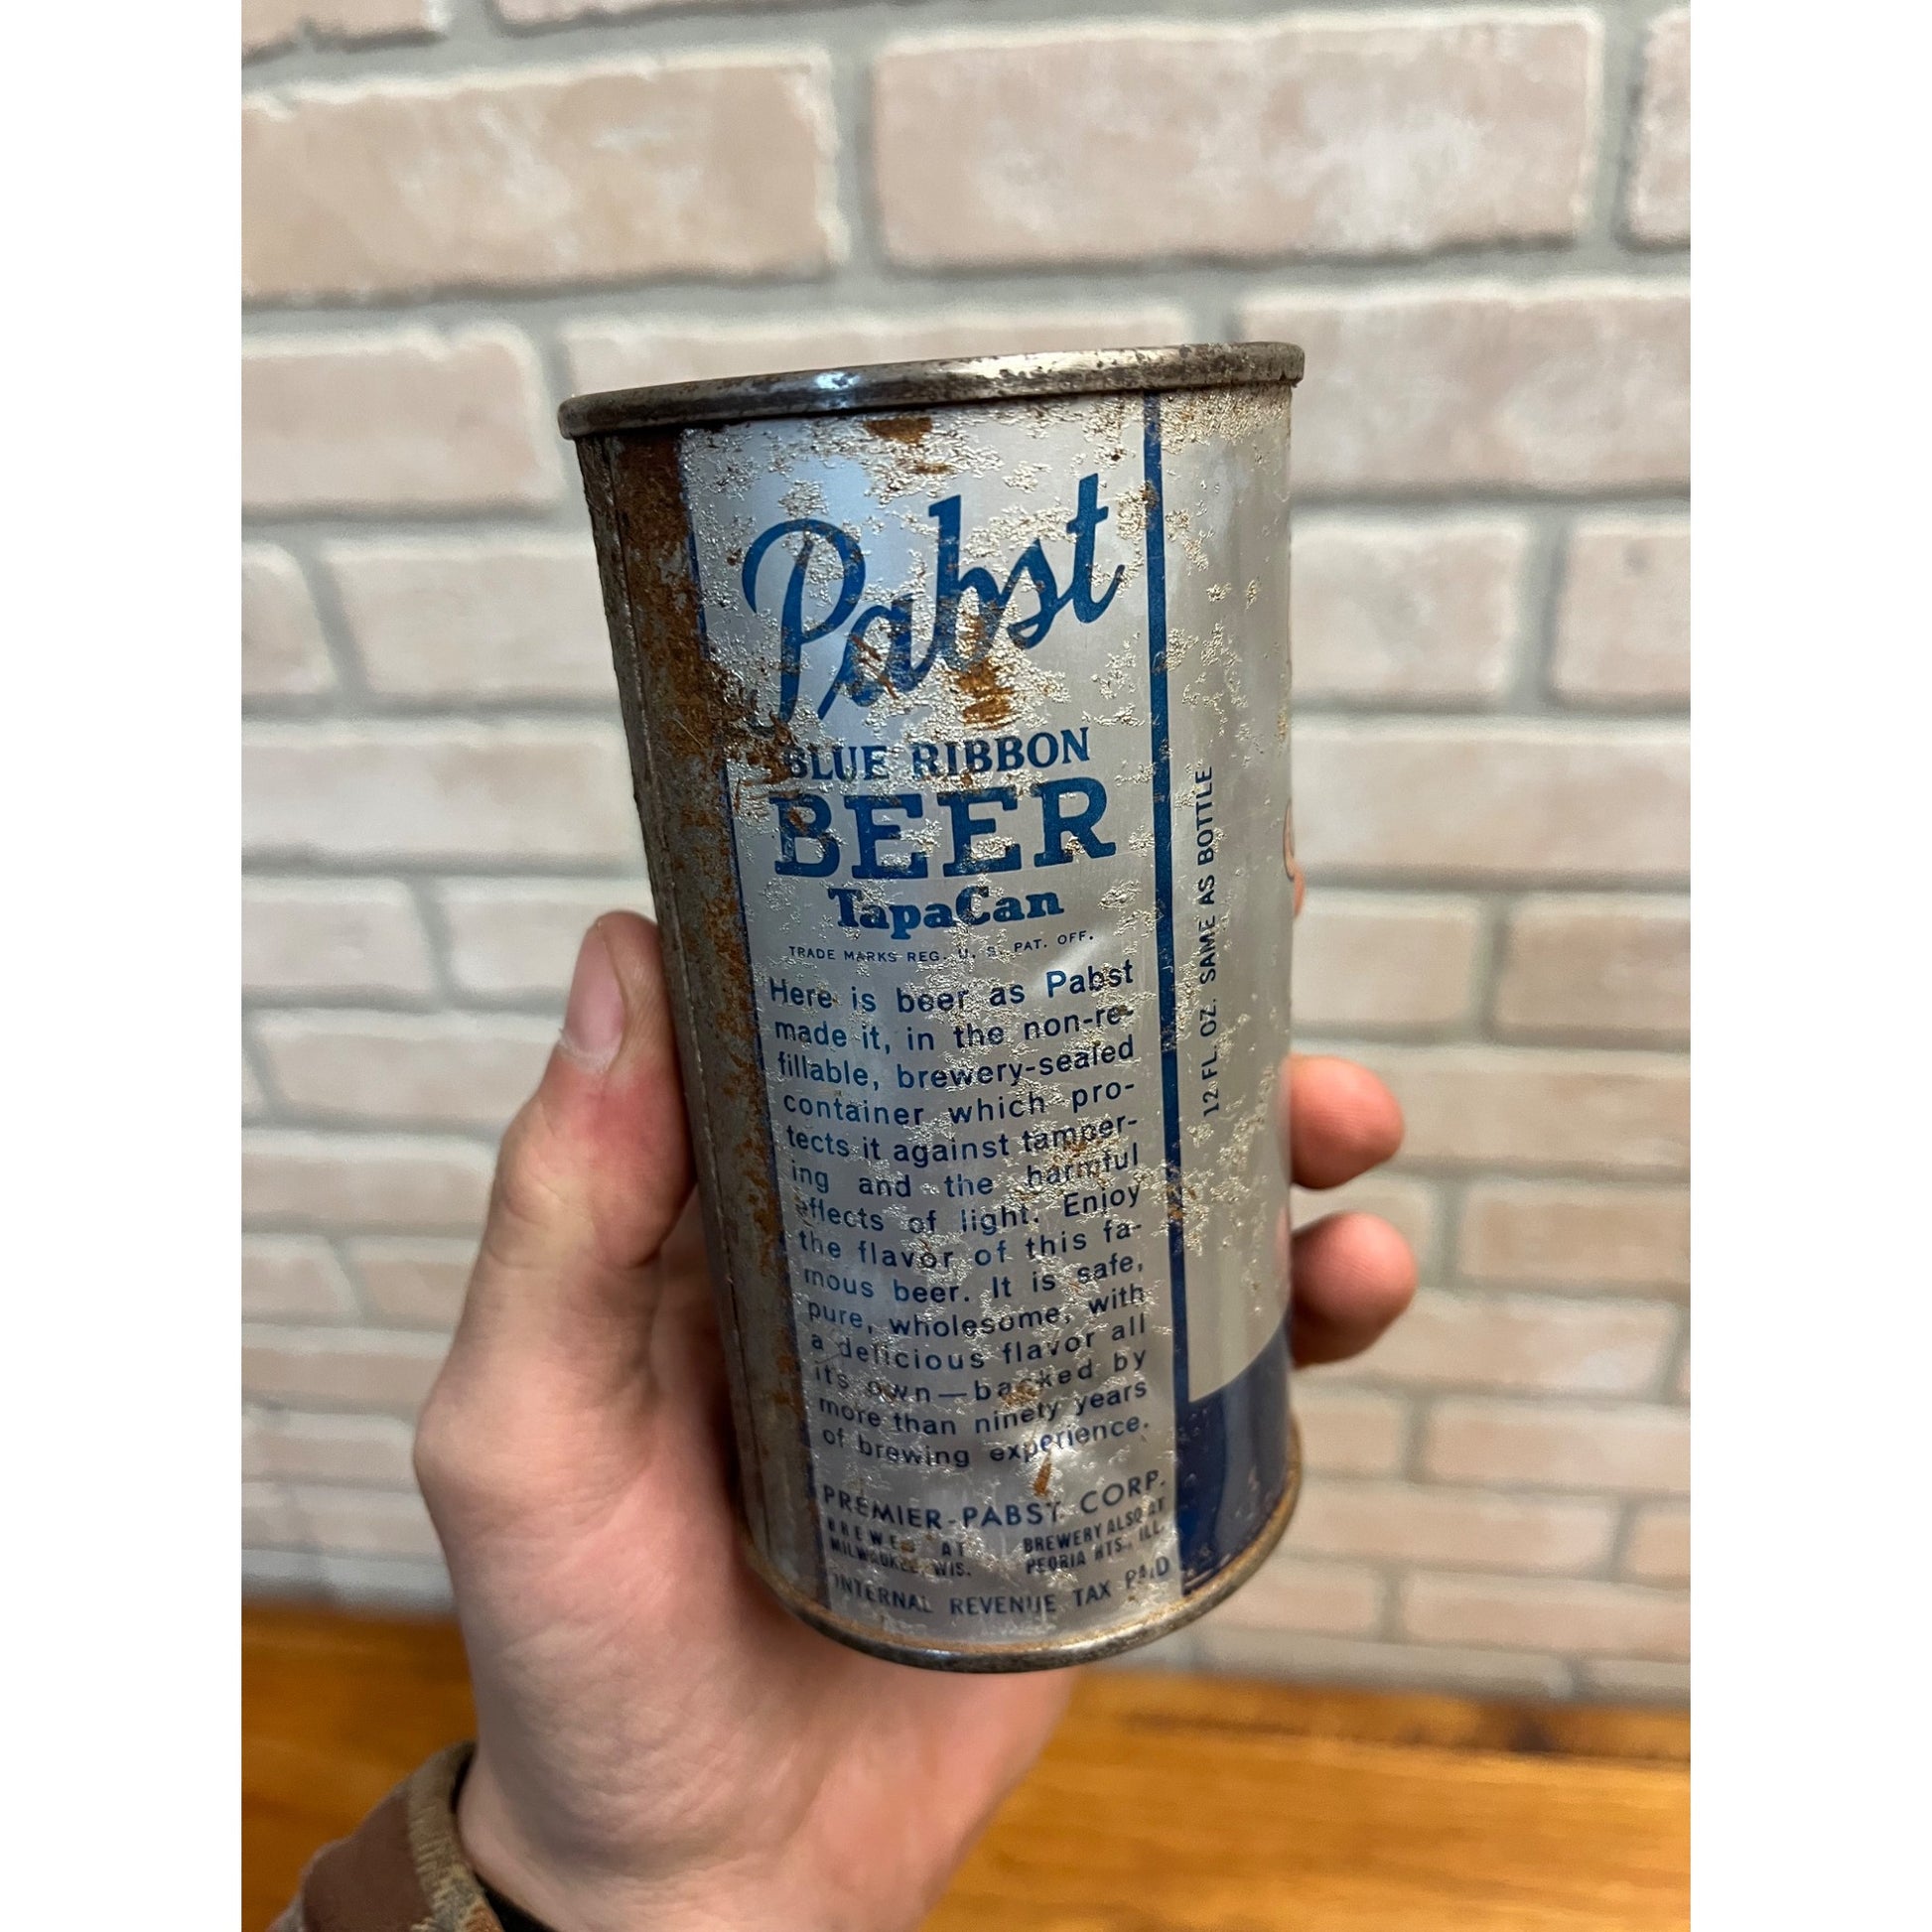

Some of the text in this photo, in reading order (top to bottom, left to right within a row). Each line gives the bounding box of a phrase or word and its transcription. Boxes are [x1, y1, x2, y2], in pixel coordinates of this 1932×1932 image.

[742, 473, 1124, 723] Pabst
[788, 727, 1090, 780] BLUE RIBBON
[768, 776, 1116, 880] BEER
[828, 886, 1064, 940] TapaCan
[788, 946, 835, 960] TRADE
[844, 949, 897, 962] MARKS
[907, 950, 947, 962] REG.
[1014, 939, 1047, 953] PAT.
[1057, 930, 1094, 944] OFF.
[1194, 766, 1220, 1117] 12 FL. OZ. SAME AS BOTTLE
[769, 959, 1134, 1014] Here is beer as Pabst
[774, 1019, 847, 1046] made
[862, 1027, 891, 1054] it,
[907, 1027, 934, 1051] in
[953, 1024, 1005, 1049] the
[777, 1035, 1135, 1090] fillable, brewery-sealed
[783, 1082, 1135, 1126] container which pro-
[786, 1125, 850, 1158] tects
[862, 1136, 881, 1161] it
[894, 1133, 1010, 1168] against
[791, 1142, 1139, 1197] ing and the harmful
[907, 1209, 937, 1234] of
[961, 1204, 1039, 1236] light.
[1063, 1183, 1141, 1218] Enjoy
[798, 1219, 1142, 1269] the flavor of this fa-
[803, 1254, 1144, 1304] mous beer. It is safe,
[807, 1282, 1146, 1337] pure, wholesome, with
[811, 1314, 1146, 1371] a delicious flavor all
[815, 1361, 850, 1389] its
[1114, 1348, 1147, 1372] by
[819, 1381, 1148, 1436] more than ninety years
[823, 1415, 1150, 1467] of brewing experience.
[1080, 1469, 1166, 1514] CORP.
[827, 1517, 965, 1557] BREWE AT
[1023, 1496, 1166, 1554] BREWERY ALSO AT
[1027, 1550, 1086, 1575] PEORIA
[834, 1574, 933, 1613] INTERNAL
[950, 1593, 1056, 1615] REVENUE
[1073, 1580, 1112, 1607] TAX
